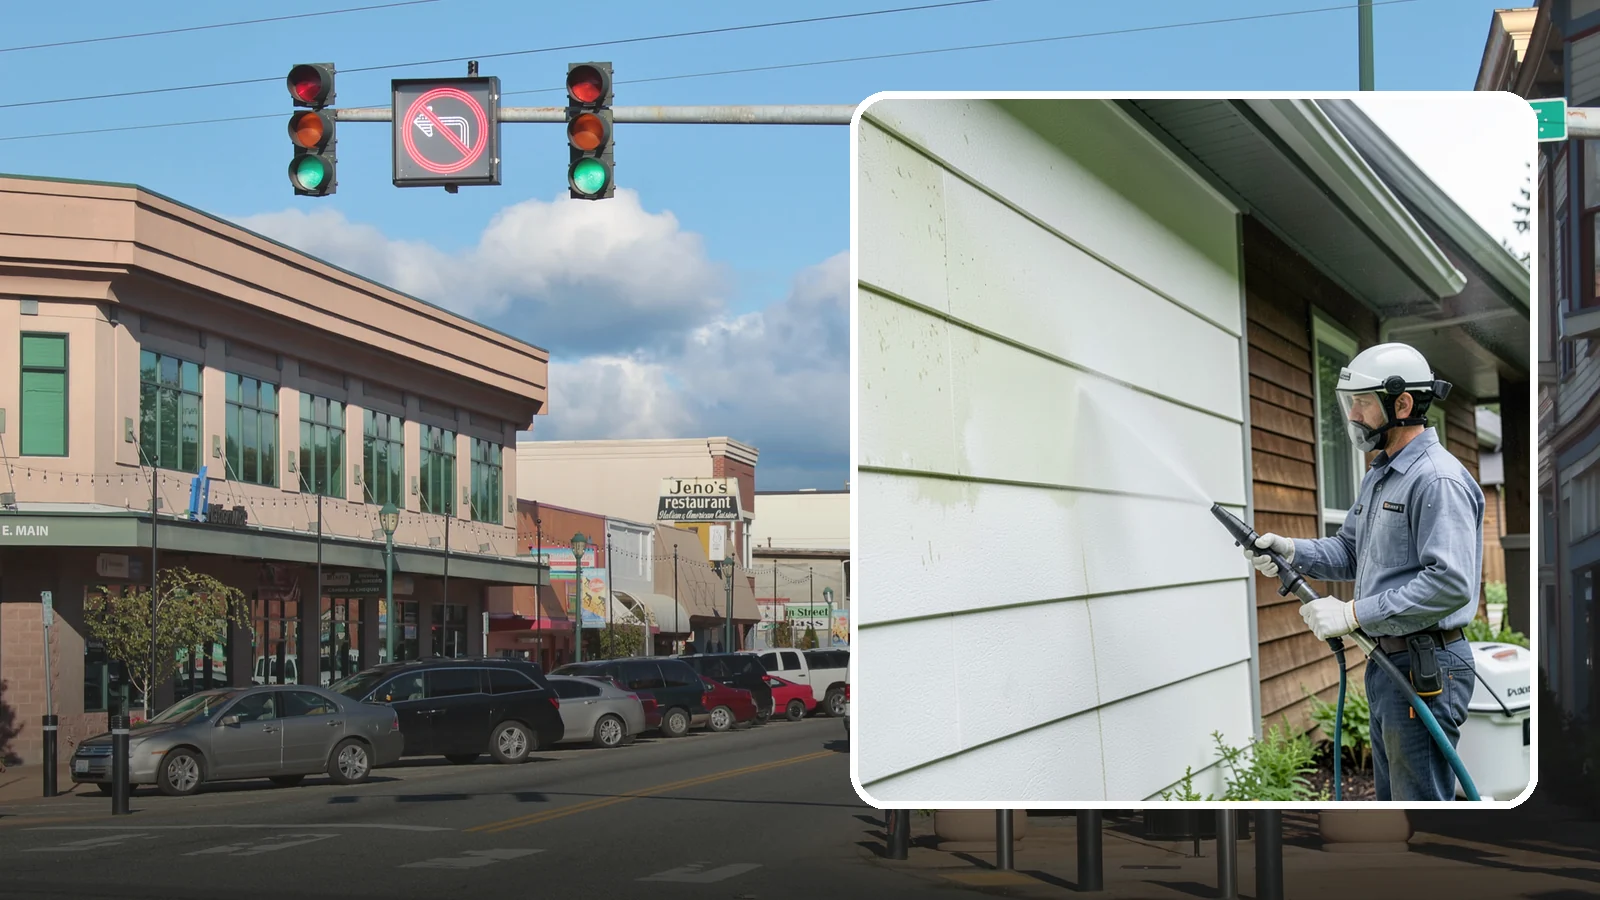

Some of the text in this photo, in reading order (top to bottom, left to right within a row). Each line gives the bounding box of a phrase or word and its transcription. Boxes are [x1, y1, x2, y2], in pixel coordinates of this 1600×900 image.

[669, 480, 728, 494] Jeno's
[665, 496, 731, 509] restaurant
[658, 510, 682, 520] Italian
[686, 510, 714, 519] American
[715, 509, 738, 519] Cuisine
[2, 525, 49, 536] E. MAIN
[797, 608, 828, 617] Street
